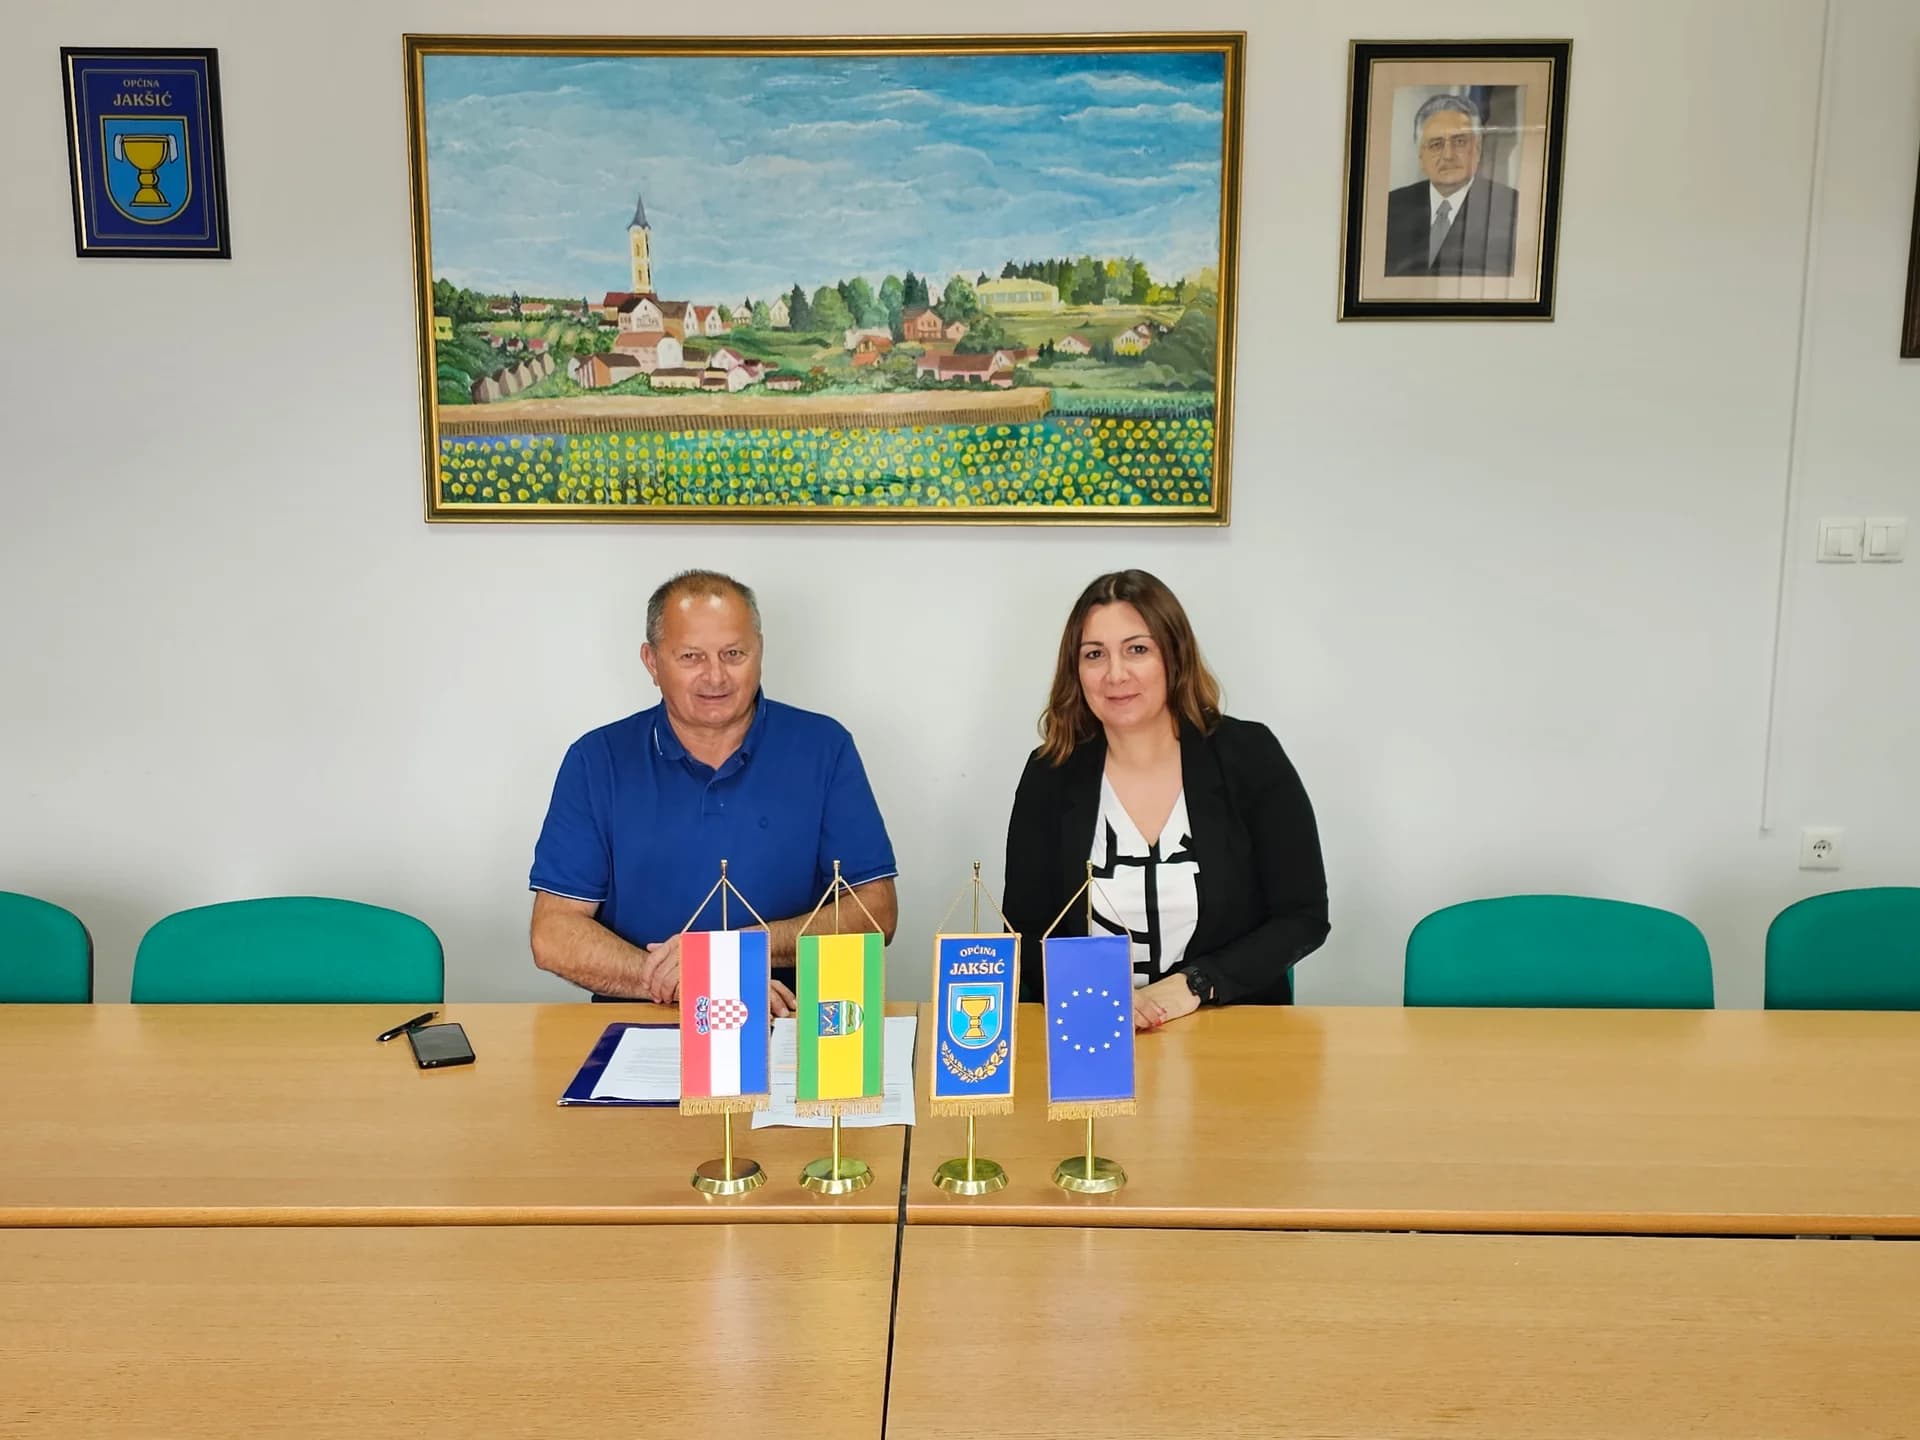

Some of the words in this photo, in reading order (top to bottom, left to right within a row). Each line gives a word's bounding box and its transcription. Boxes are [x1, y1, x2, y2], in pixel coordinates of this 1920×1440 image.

[123, 78, 160, 88] OPČINA
[113, 90, 172, 107] JAKŠIĆ
[960, 944, 997, 957] OPČINA
[949, 959, 1005, 976] JAKŠIĆ
